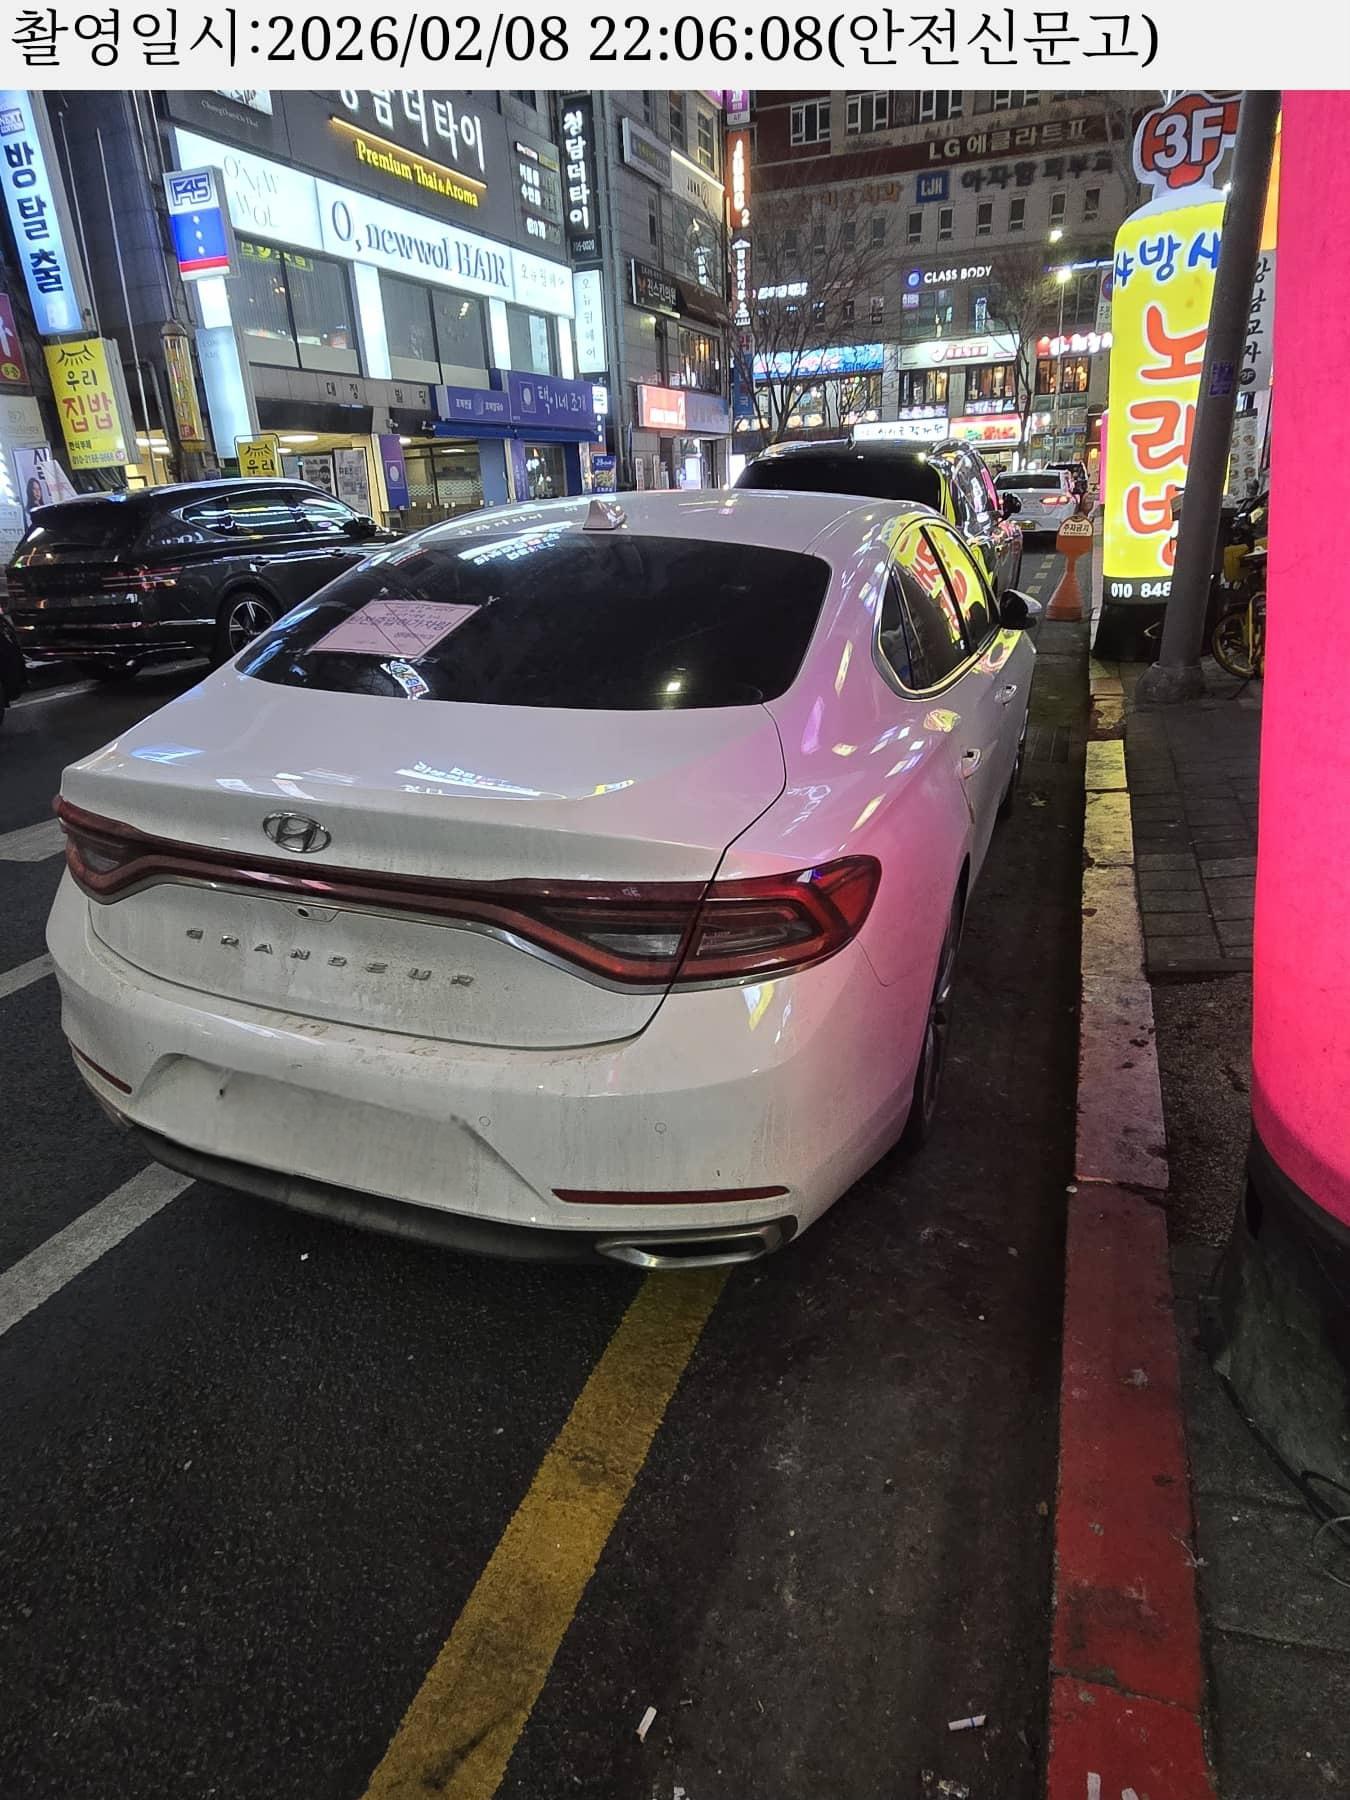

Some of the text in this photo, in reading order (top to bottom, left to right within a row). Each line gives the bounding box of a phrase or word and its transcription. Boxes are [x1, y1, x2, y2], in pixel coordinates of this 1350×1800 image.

[1153, 106, 1224, 169] 3F
[355, 139, 414, 181] Premium
[563, 110, 590, 230] 청담더타이
[171, 174, 211, 205] F45
[4, 142, 64, 294] 방탈출
[366, 222, 450, 274] newwol
[456, 240, 510, 288] HAIR
[924, 265, 993, 284] CLASS BODY
[66, 368, 98, 392] 우리
[62, 391, 113, 433] 집밥
[246, 459, 275, 475] 우리
[1111, 582, 1133, 598] 010
[186, 928, 474, 987] GRANDEUR
